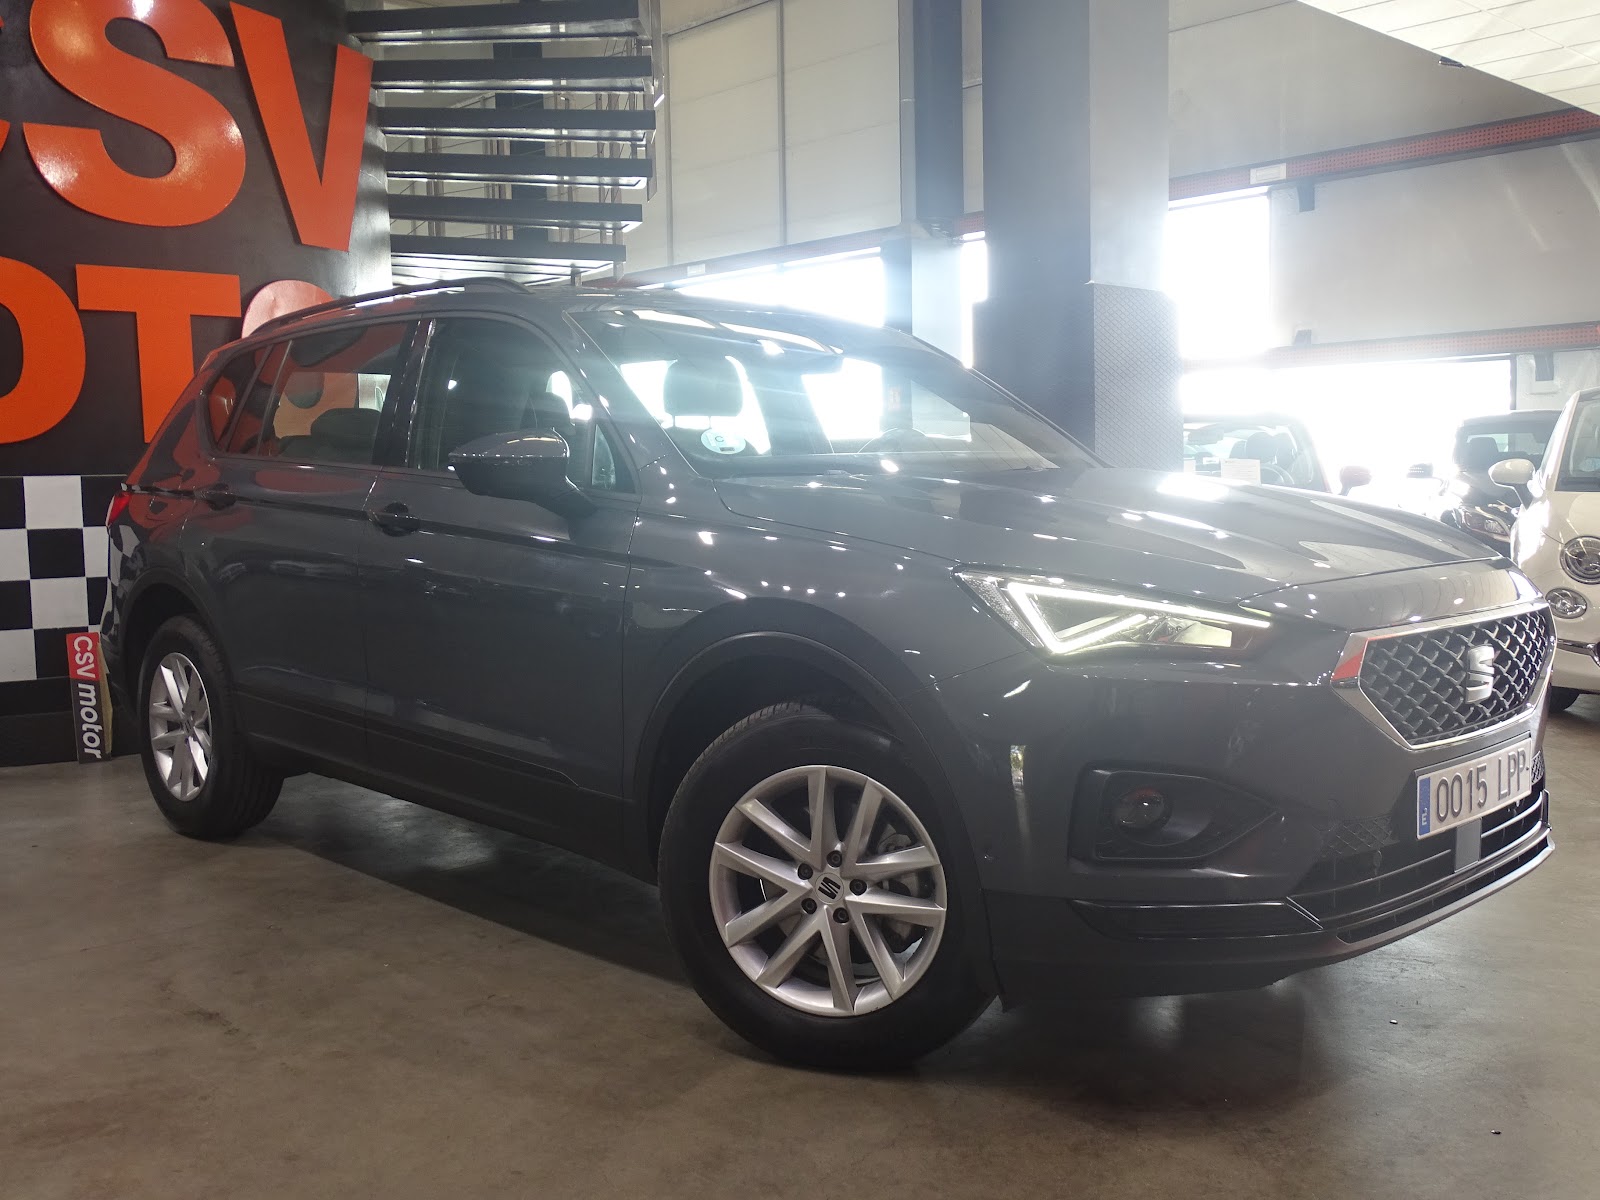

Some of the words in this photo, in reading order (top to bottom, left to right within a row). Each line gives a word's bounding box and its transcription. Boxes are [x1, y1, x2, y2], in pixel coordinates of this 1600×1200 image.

[0, 0, 373, 252] SV
[73, 635, 96, 679] CSV
[77, 683, 103, 759] motor
[1436, 763, 1488, 823] 0015
[1498, 747, 1526, 800] LPP
